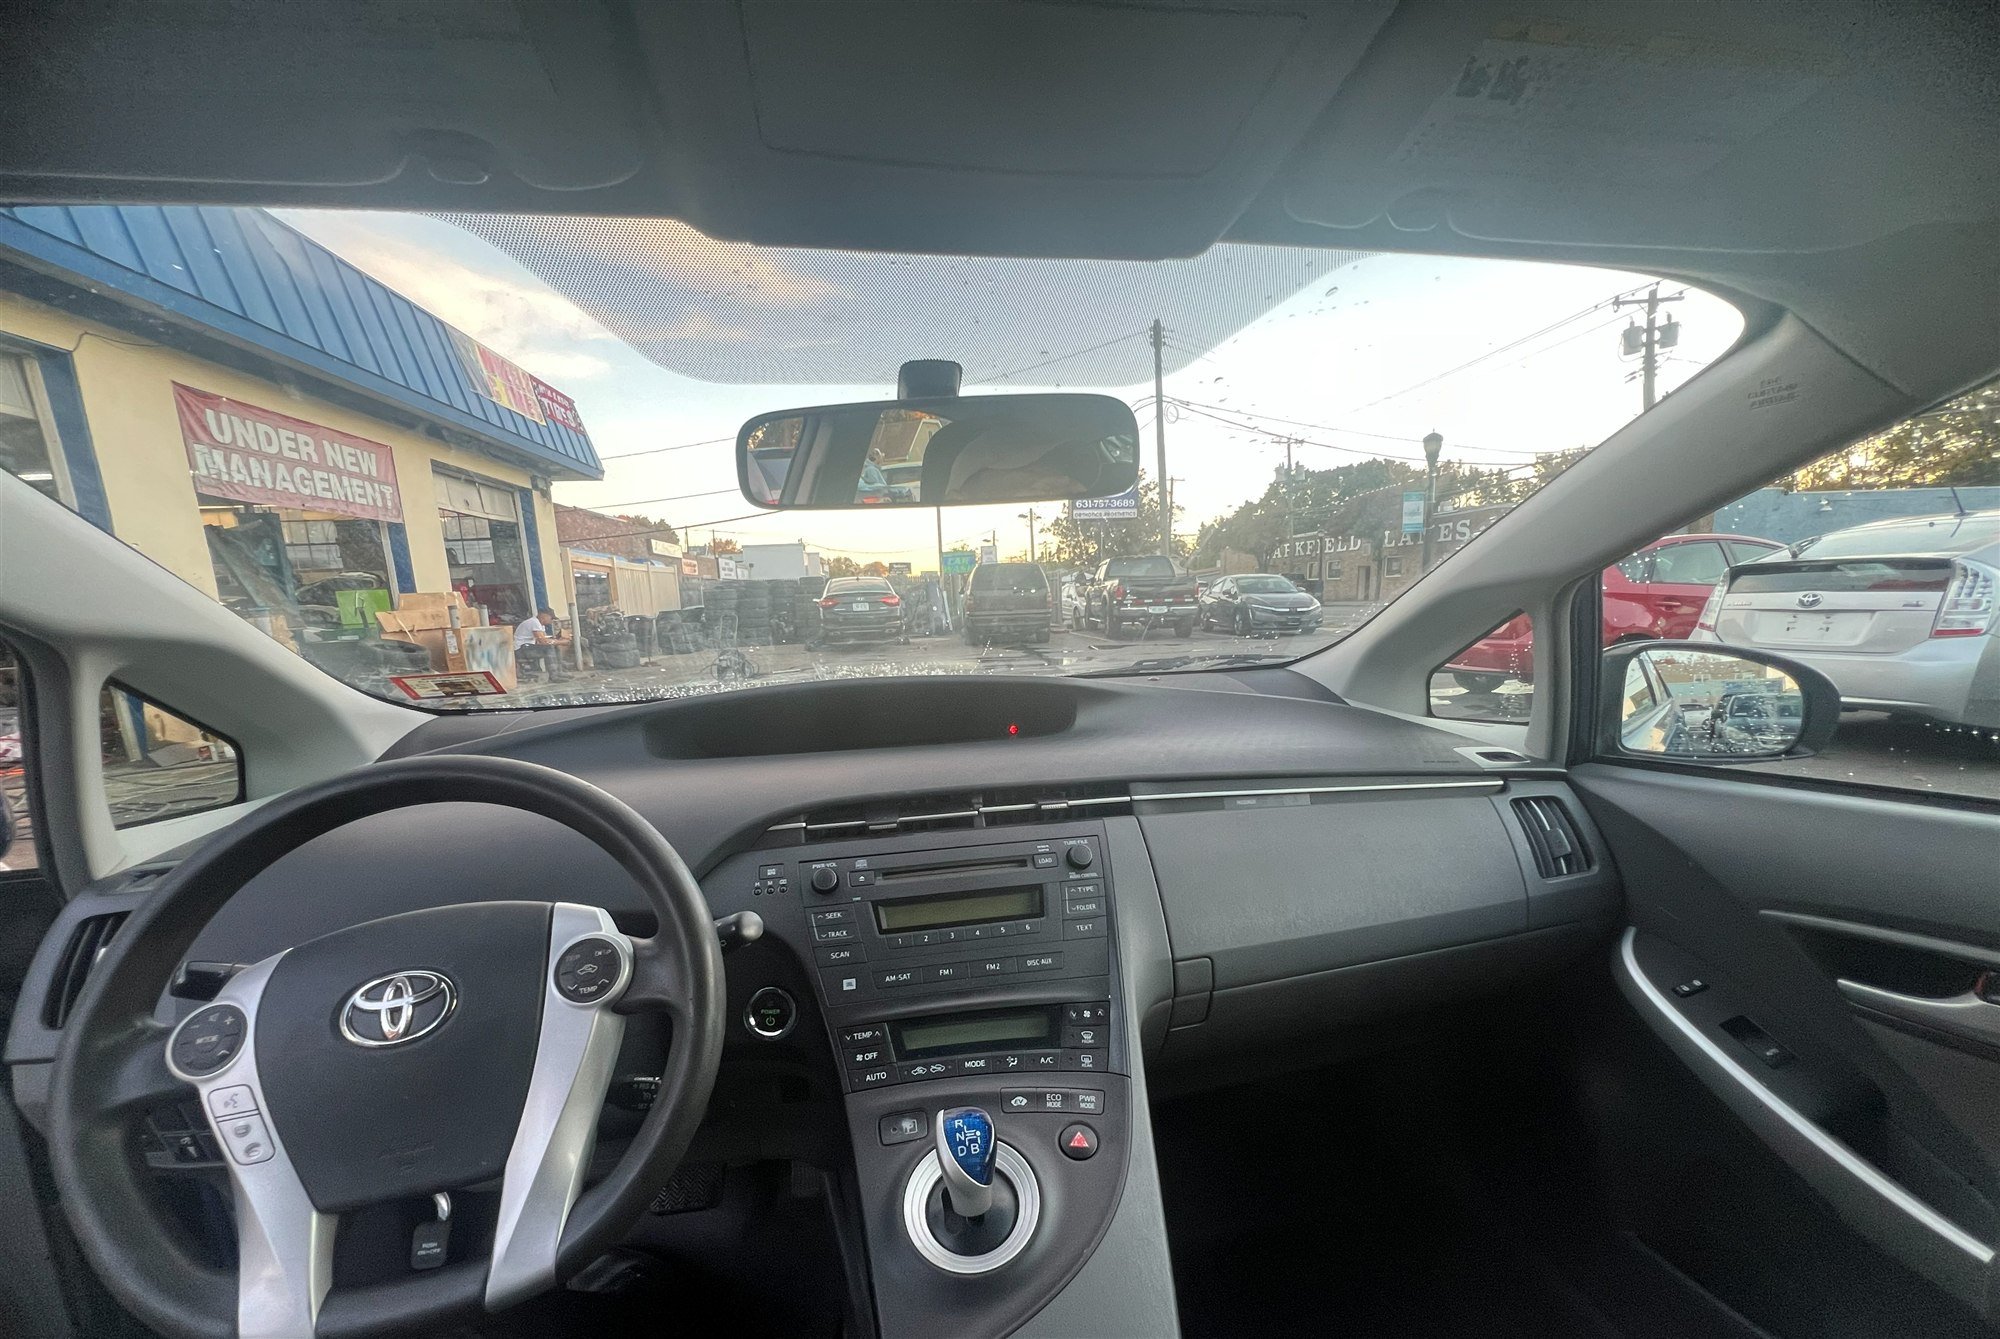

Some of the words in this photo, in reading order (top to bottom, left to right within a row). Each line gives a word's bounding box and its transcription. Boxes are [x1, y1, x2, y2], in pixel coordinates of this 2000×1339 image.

[205, 408, 319, 464] UNDER
[322, 439, 377, 477] NEW
[192, 443, 393, 510] MANAGEMENT
[1076, 499, 1135, 508] 631-757-3689
[1078, 885, 1095, 893] TYPE
[825, 911, 843, 919] SEEK
[1000, 926, 1006, 934] 5
[1025, 923, 1032, 931] 6
[828, 930, 848, 938] TRACK
[949, 931, 956, 939] 3
[975, 929, 981, 937] 4
[923, 935, 929, 943] 2
[830, 951, 850, 960] SCAN
[579, 985, 598, 994] TEMP
[853, 1031, 873, 1041] TEMP
[864, 1052, 878, 1061] OFF
[1040, 1056, 1054, 1064] A/C
[964, 1060, 986, 1068] MODE
[865, 1072, 887, 1082] AUTO
[1046, 1093, 1062, 1101] ECO
[1079, 1095, 1096, 1103] PWR
[1079, 1102, 1096, 1110] MODE
[954, 1119, 963, 1128] R
[956, 1131, 965, 1141] N
[957, 1145, 967, 1157] D
[970, 1143, 980, 1154] B
